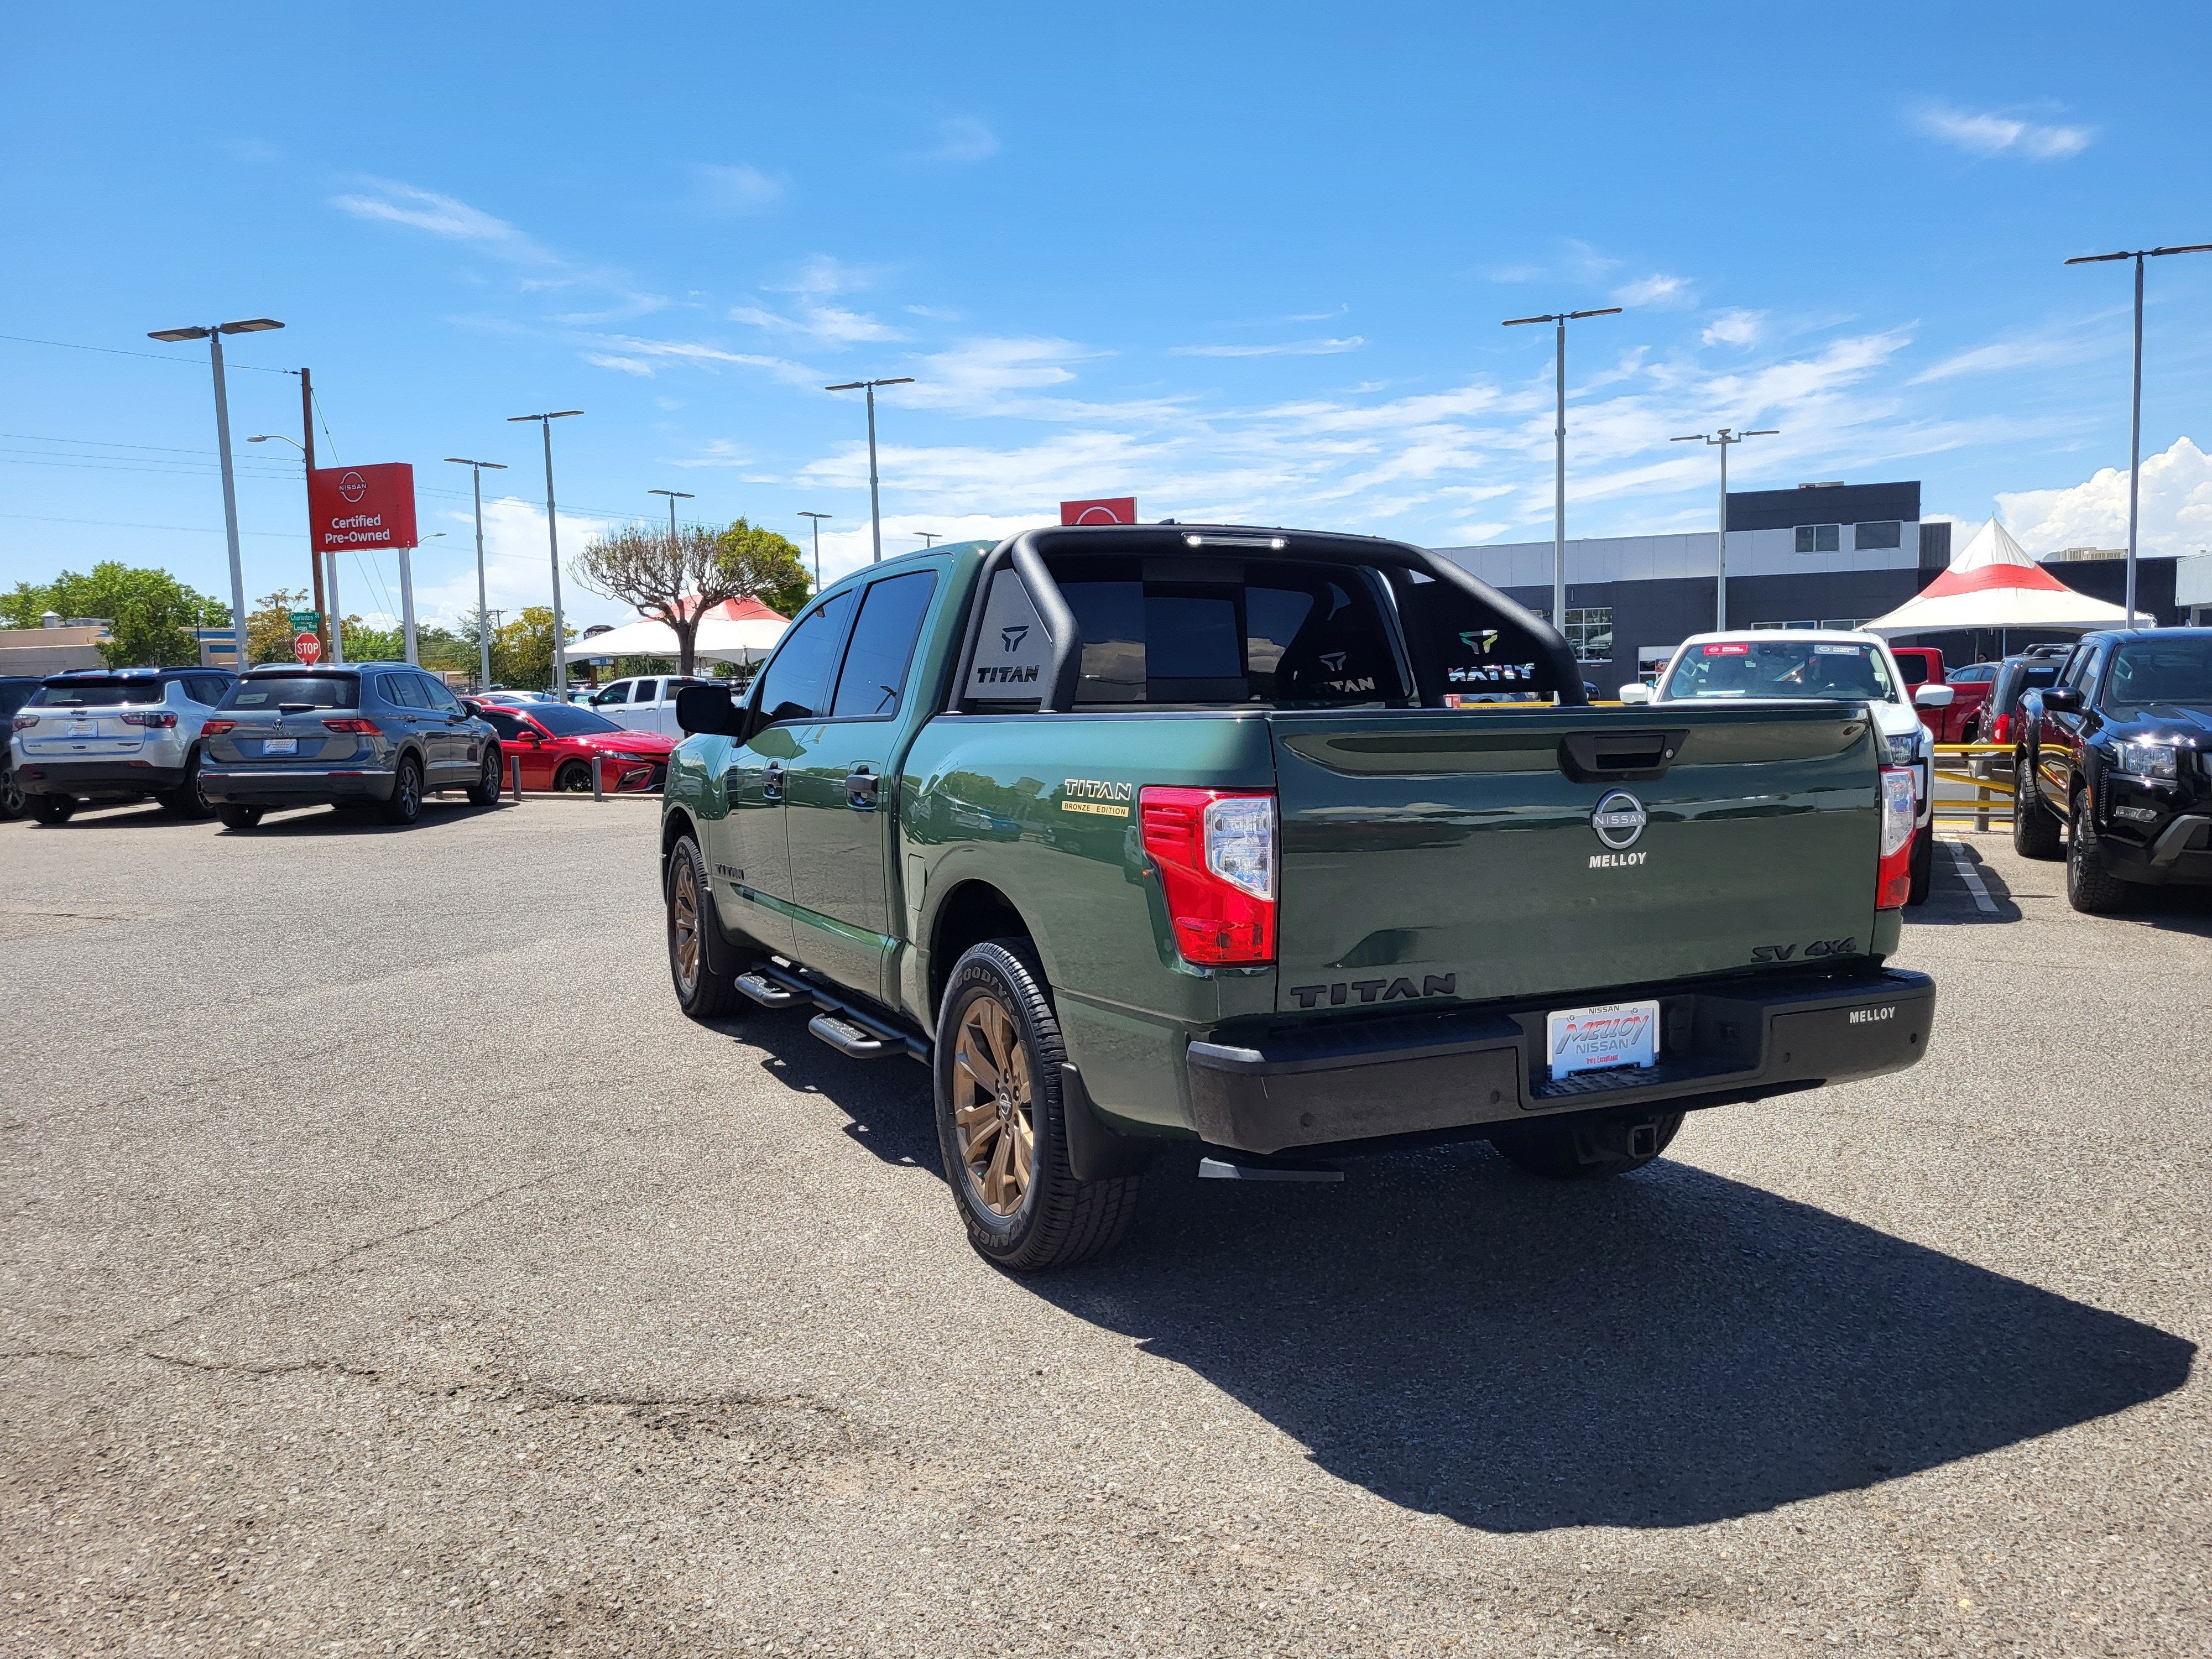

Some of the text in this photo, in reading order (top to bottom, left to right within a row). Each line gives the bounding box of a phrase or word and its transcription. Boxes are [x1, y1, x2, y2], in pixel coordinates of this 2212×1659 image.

[332, 514, 381, 529] Certified
[325, 529, 390, 544] Pre-Owned
[297, 643, 319, 654] STOP
[977, 665, 1040, 683] TITAN
[1322, 676, 1375, 692] TAN
[1065, 779, 1133, 801] TITAN
[1064, 803, 1126, 815] BRONZE EDITION
[1595, 814, 1645, 825] NISSAN
[1589, 852, 1647, 868] MELLOY
[714, 862, 745, 881] TITAN
[1751, 944, 1797, 962] SV
[1290, 973, 1456, 1008] TITAN
[1588, 1005, 1620, 1015] NISSAN
[1849, 1006, 1895, 1024] MELLOY
[1555, 1015, 1650, 1055] MELLOY
[1576, 1039, 1629, 1055] NISSAN
[1585, 1056, 1596, 1065] Truly
